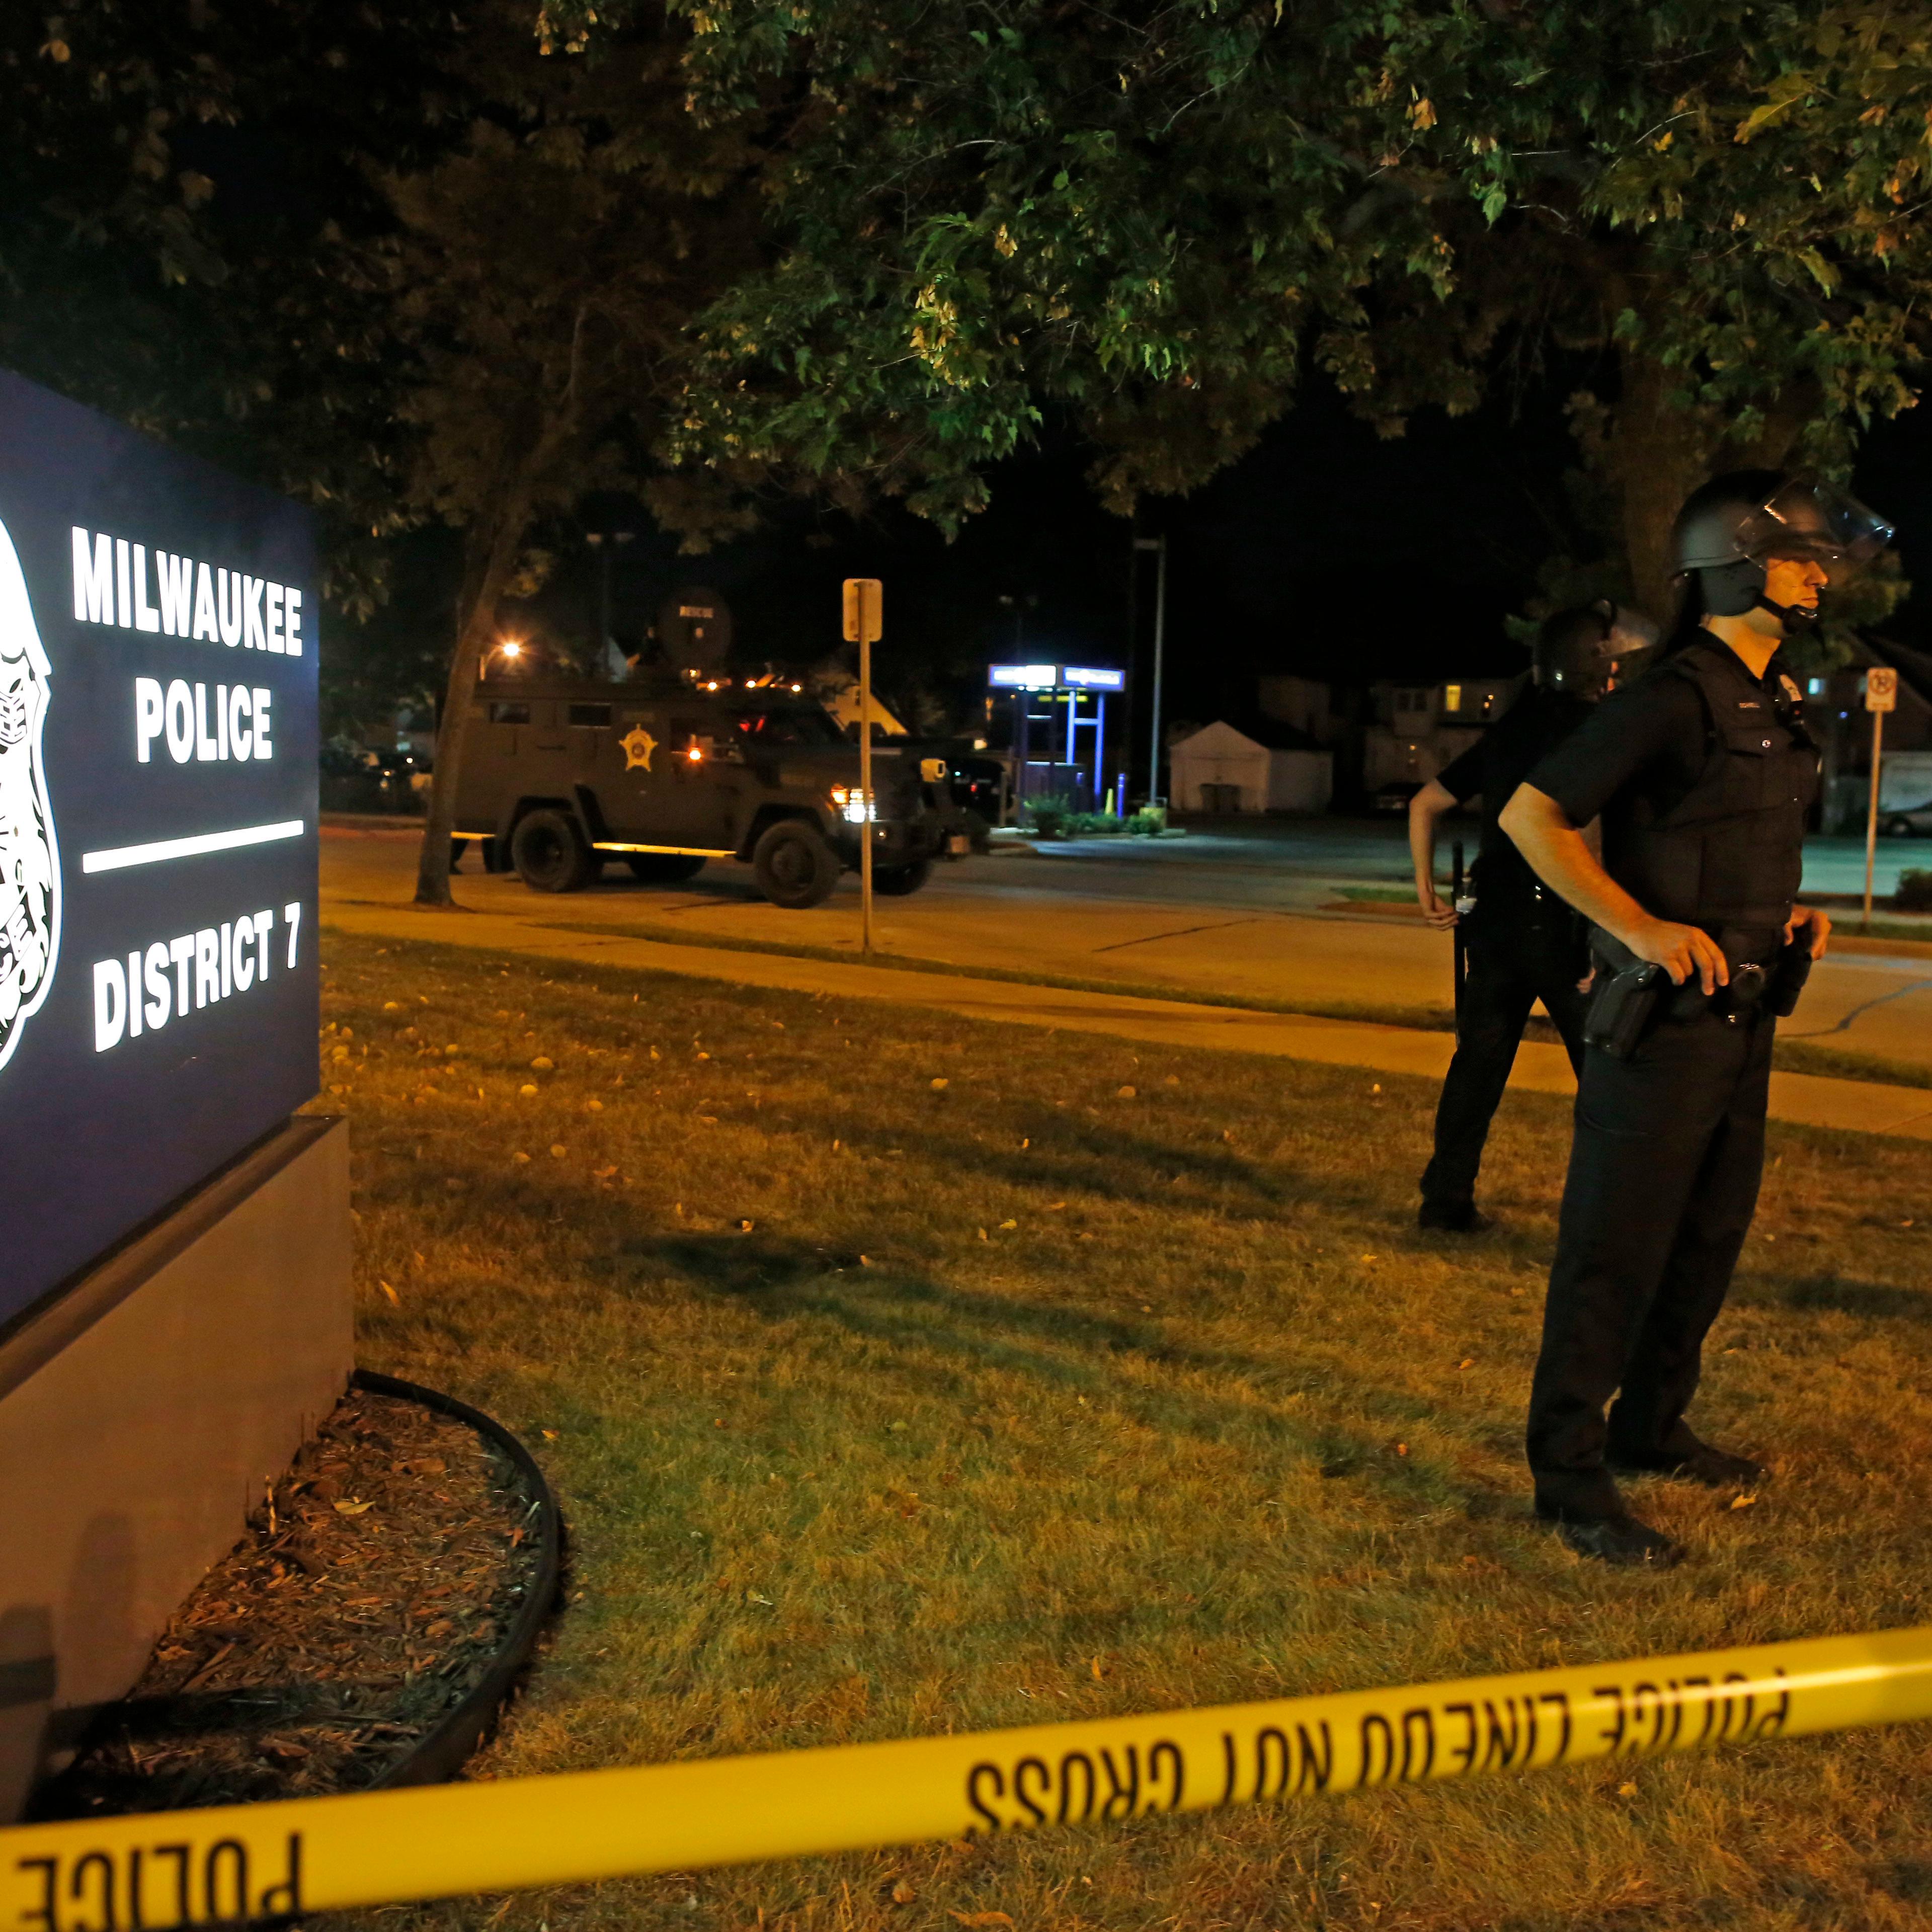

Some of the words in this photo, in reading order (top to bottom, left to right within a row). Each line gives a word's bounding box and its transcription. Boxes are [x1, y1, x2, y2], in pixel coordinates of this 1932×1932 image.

[72, 526, 302, 657] MILWAUKEE
[135, 677, 272, 764] POLICE
[94, 910, 273, 1053] DISTRICT
[285, 902, 300, 969] 7
[1590, 1667, 1791, 1754] POLICE
[967, 1740, 1183, 1832] CROSS
[18, 1831, 303, 1932] POLICE
